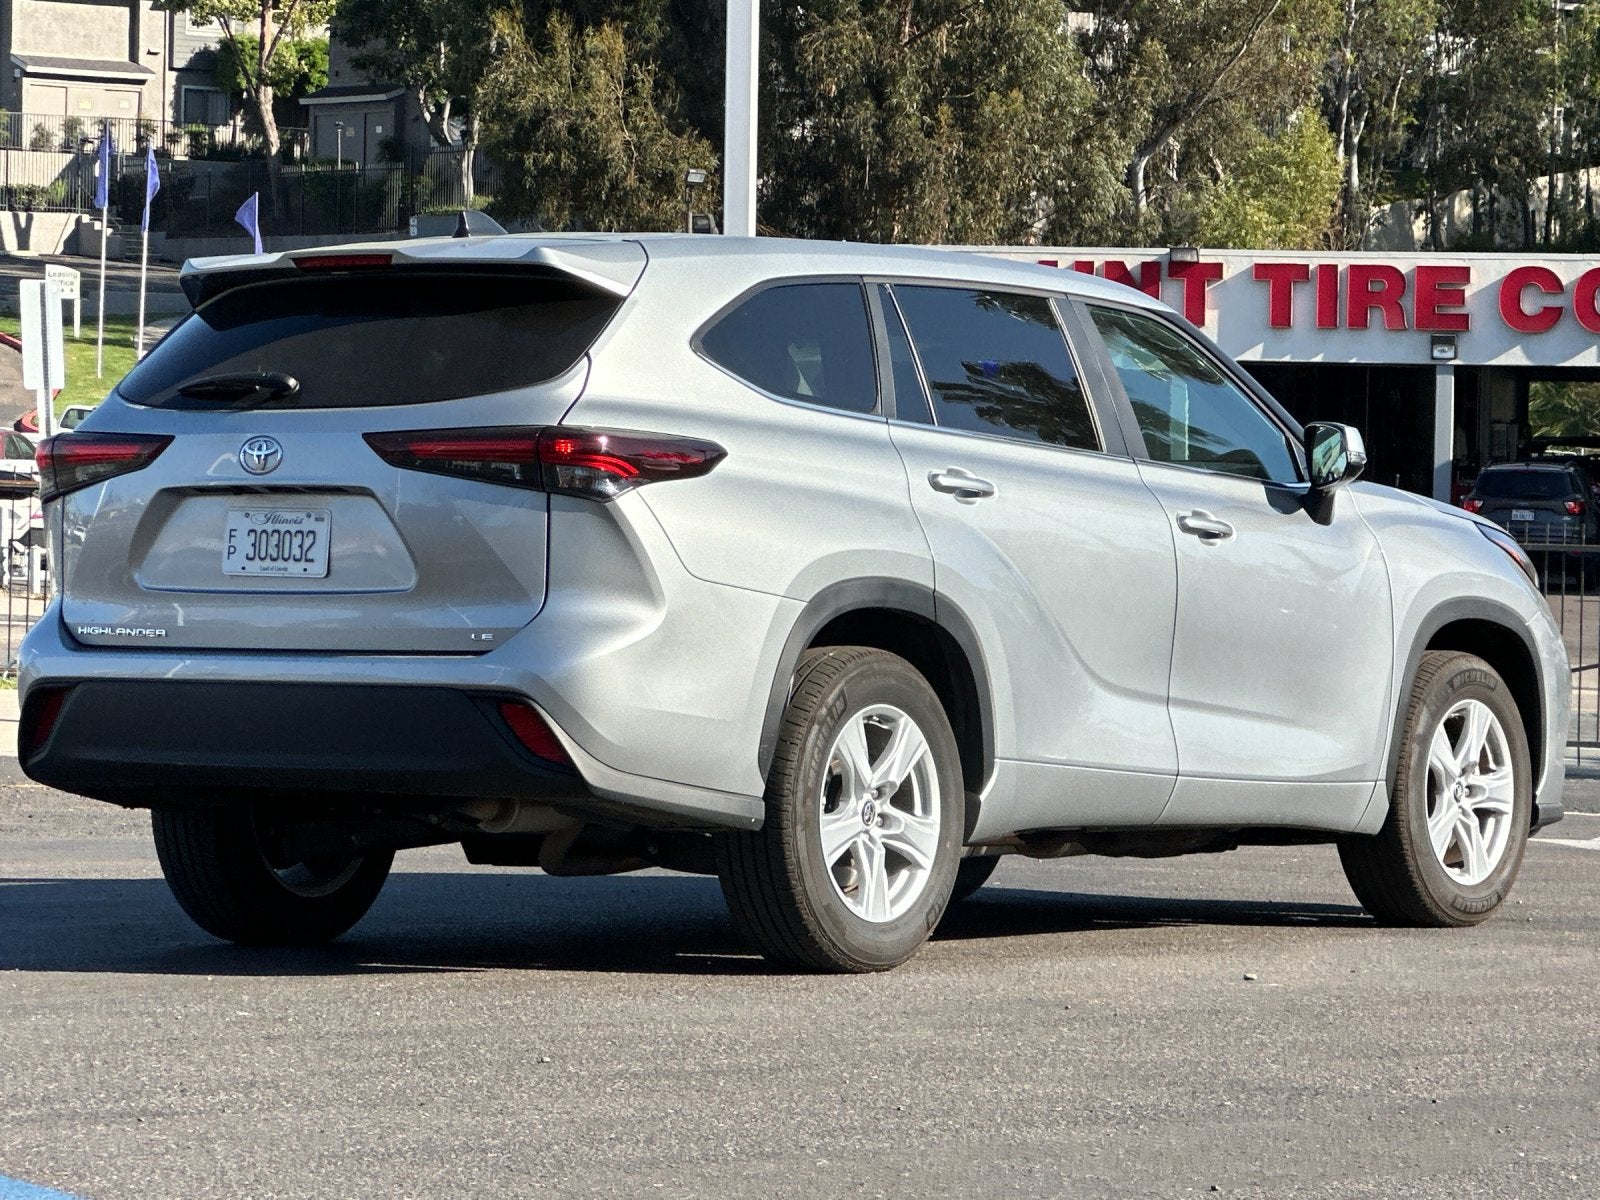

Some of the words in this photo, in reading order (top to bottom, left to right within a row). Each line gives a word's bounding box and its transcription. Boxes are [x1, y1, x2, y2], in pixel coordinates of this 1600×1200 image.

[48, 271, 78, 279] Leasing
[1038, 260, 1224, 327] NT
[1252, 262, 1472, 332] TIRE
[251, 511, 305, 526] Illinois
[246, 528, 316, 563] 303032
[77, 626, 167, 638] HIGHLANDER
